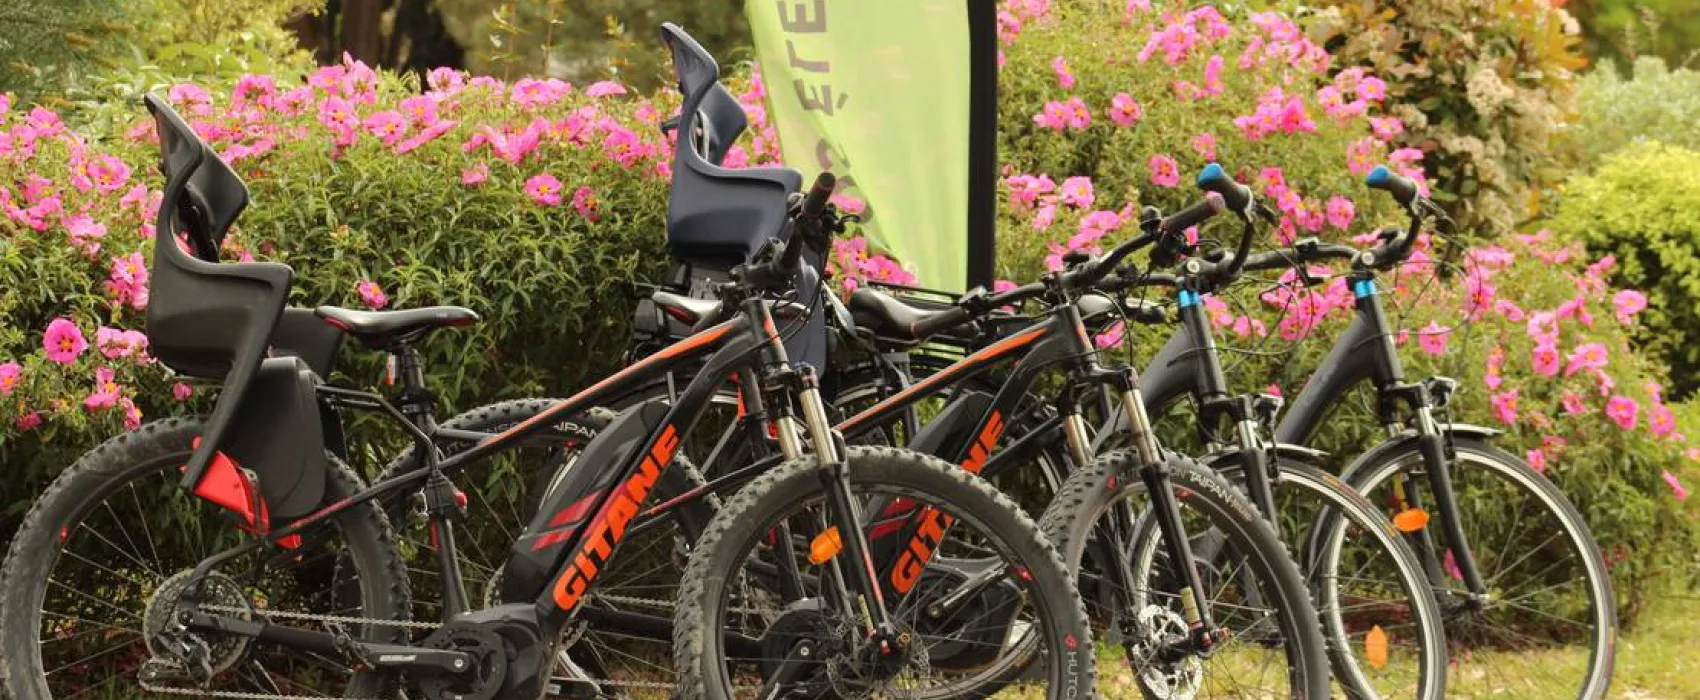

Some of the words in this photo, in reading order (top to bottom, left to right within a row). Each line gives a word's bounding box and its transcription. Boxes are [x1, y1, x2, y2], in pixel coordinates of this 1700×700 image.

[552, 424, 680, 612] GITANE
[890, 410, 1004, 593] GITNE
[1189, 469, 1232, 503] TAIPAN
[1066, 651, 1079, 700] HUTC
